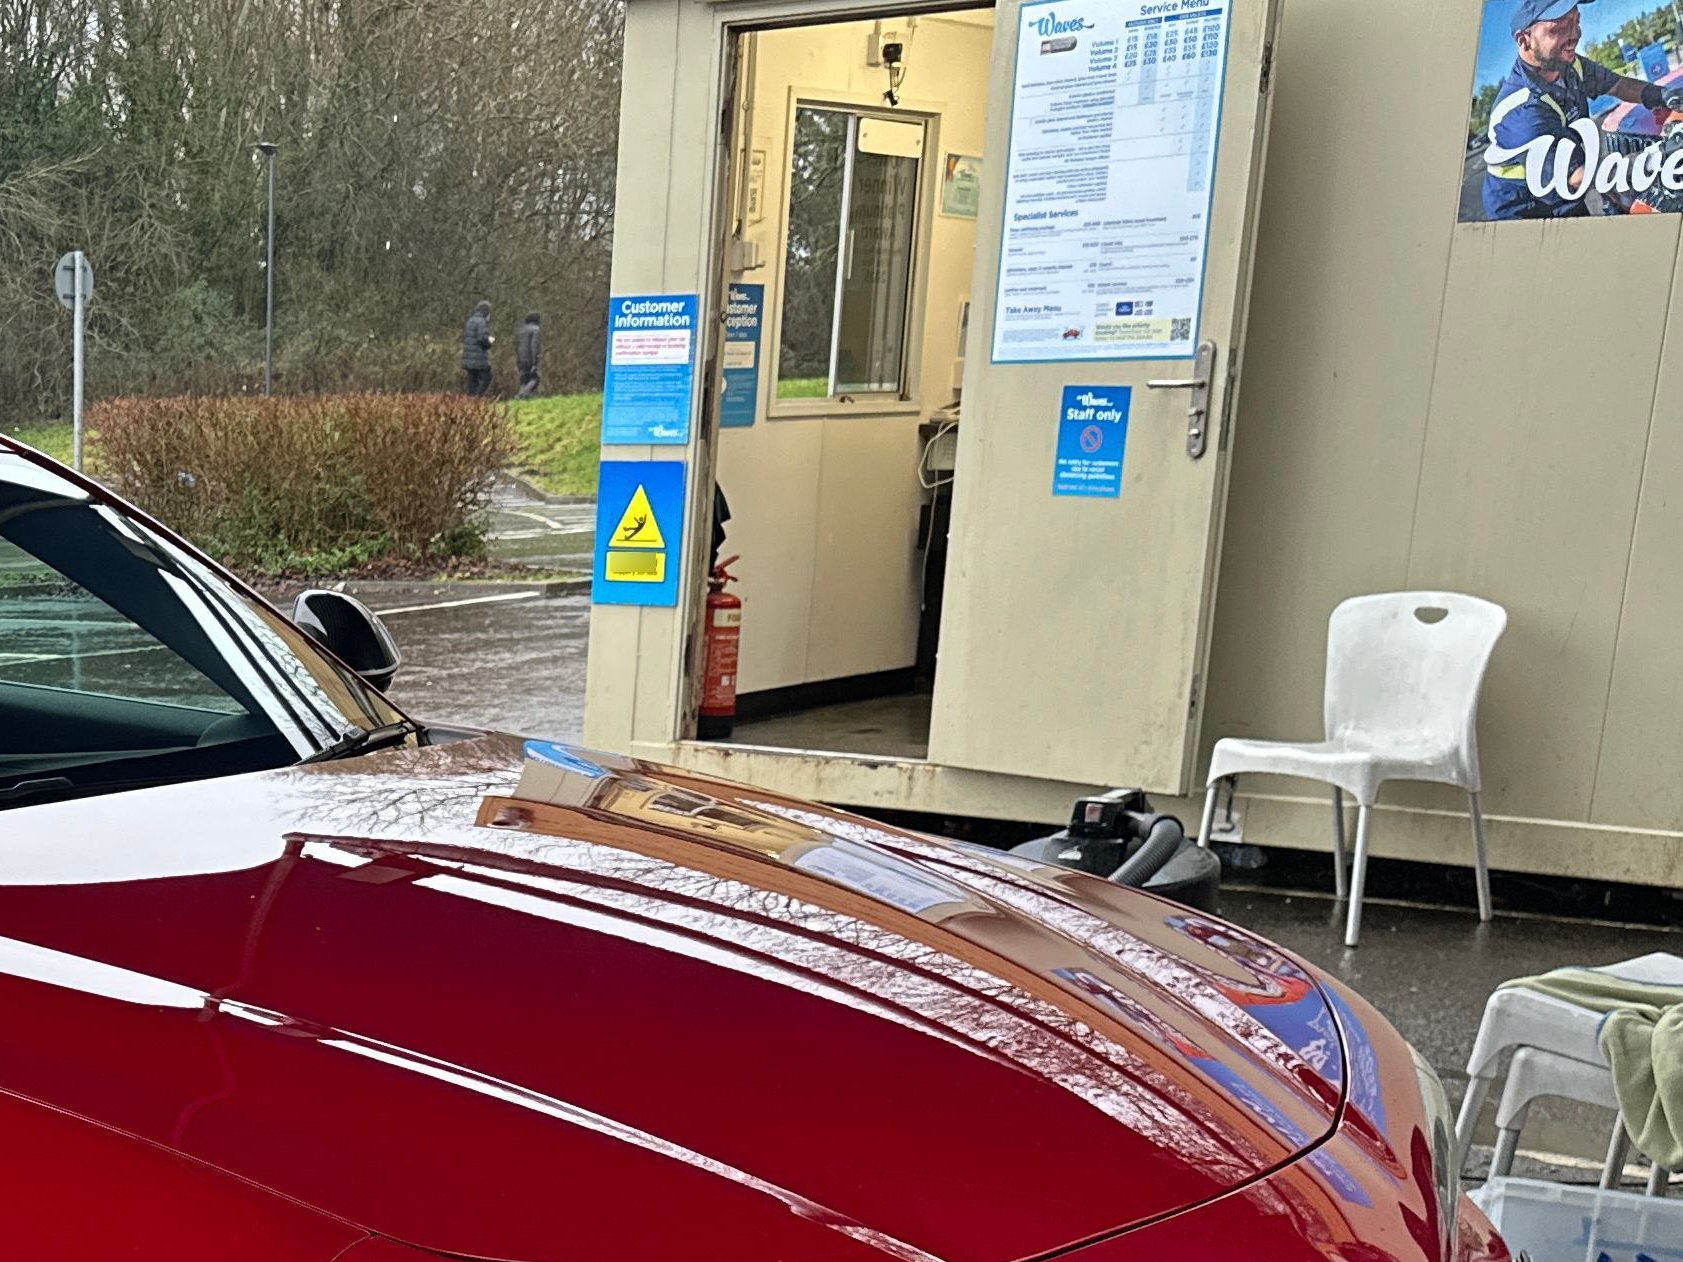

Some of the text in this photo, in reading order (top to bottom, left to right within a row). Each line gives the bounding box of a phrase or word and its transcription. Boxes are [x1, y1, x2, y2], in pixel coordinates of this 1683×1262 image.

[1140, 1, 1178, 16] Service
[1028, 11, 1094, 36] Waves
[621, 300, 685, 314] Customer
[726, 304, 758, 315] stomer
[614, 314, 690, 328] Information
[726, 316, 758, 330] ception
[1066, 407, 1122, 424] Staff only
